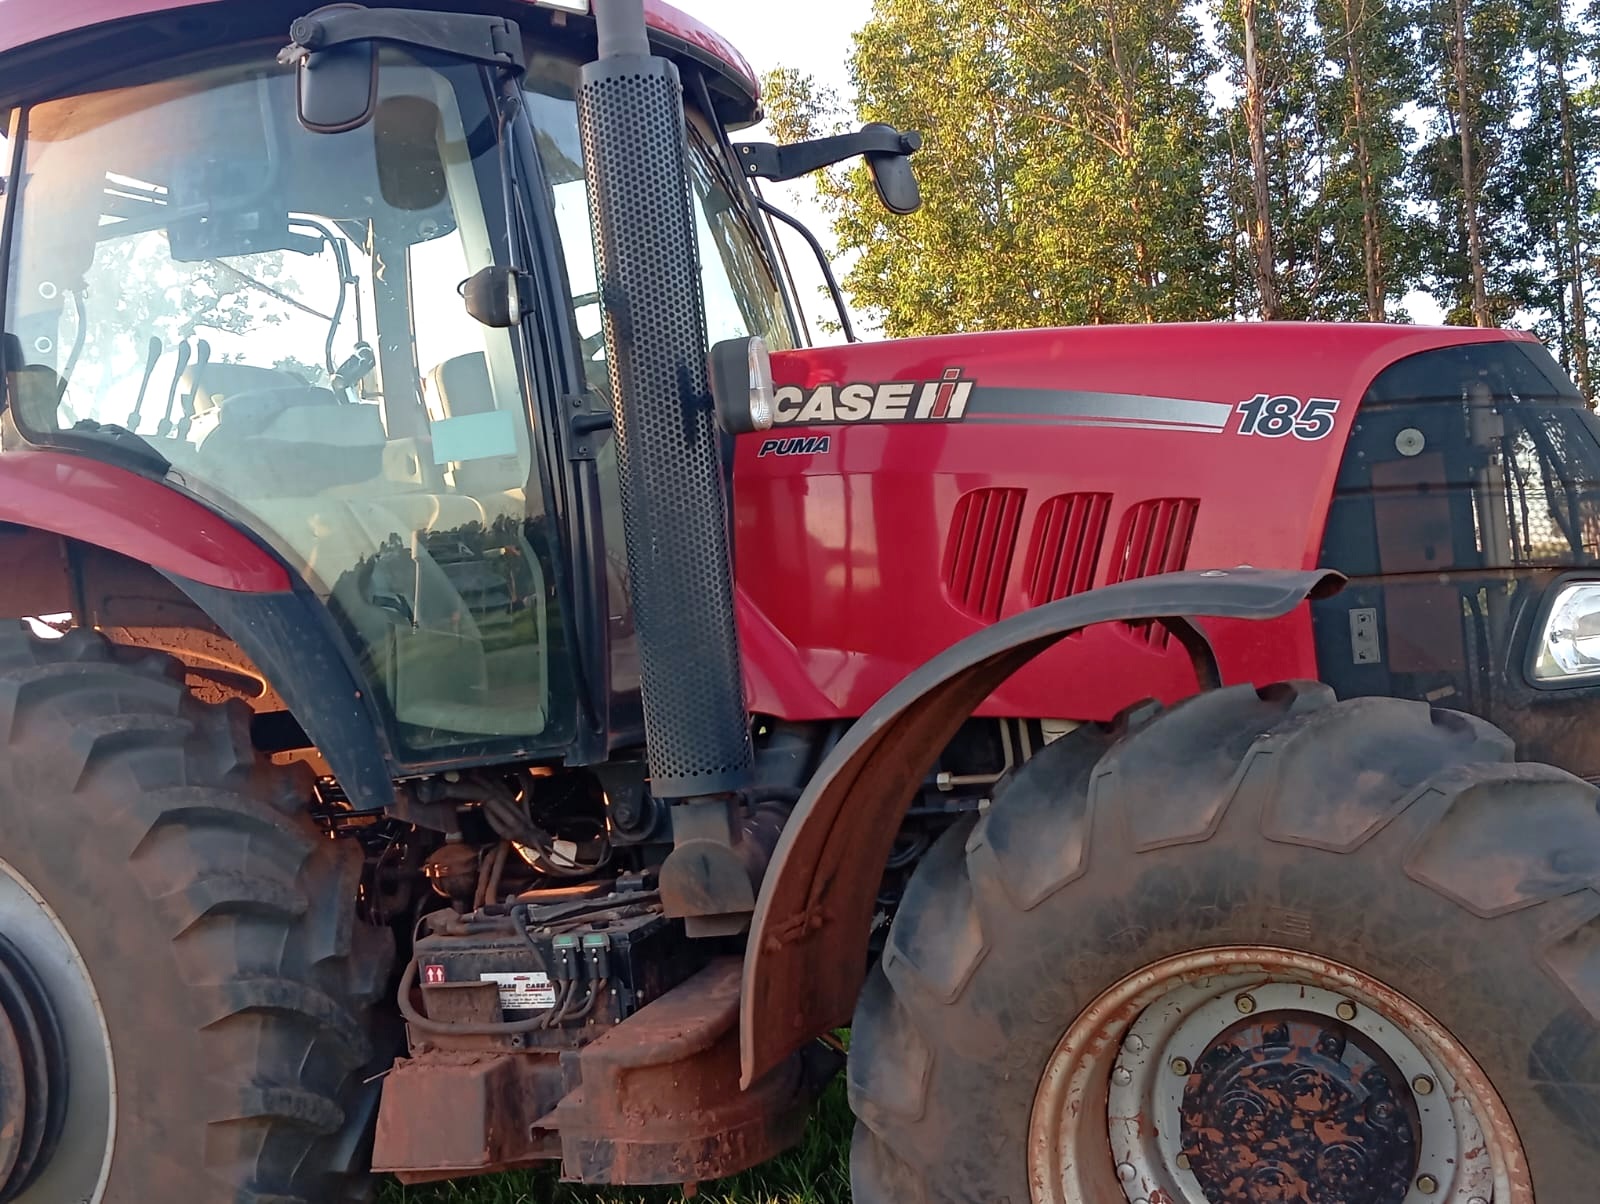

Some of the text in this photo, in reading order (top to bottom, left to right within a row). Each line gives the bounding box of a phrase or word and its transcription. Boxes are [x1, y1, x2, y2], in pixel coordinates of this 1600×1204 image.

[772, 382, 915, 423] CASE
[1236, 393, 1340, 441] 185
[757, 436, 831, 458] PUMA
